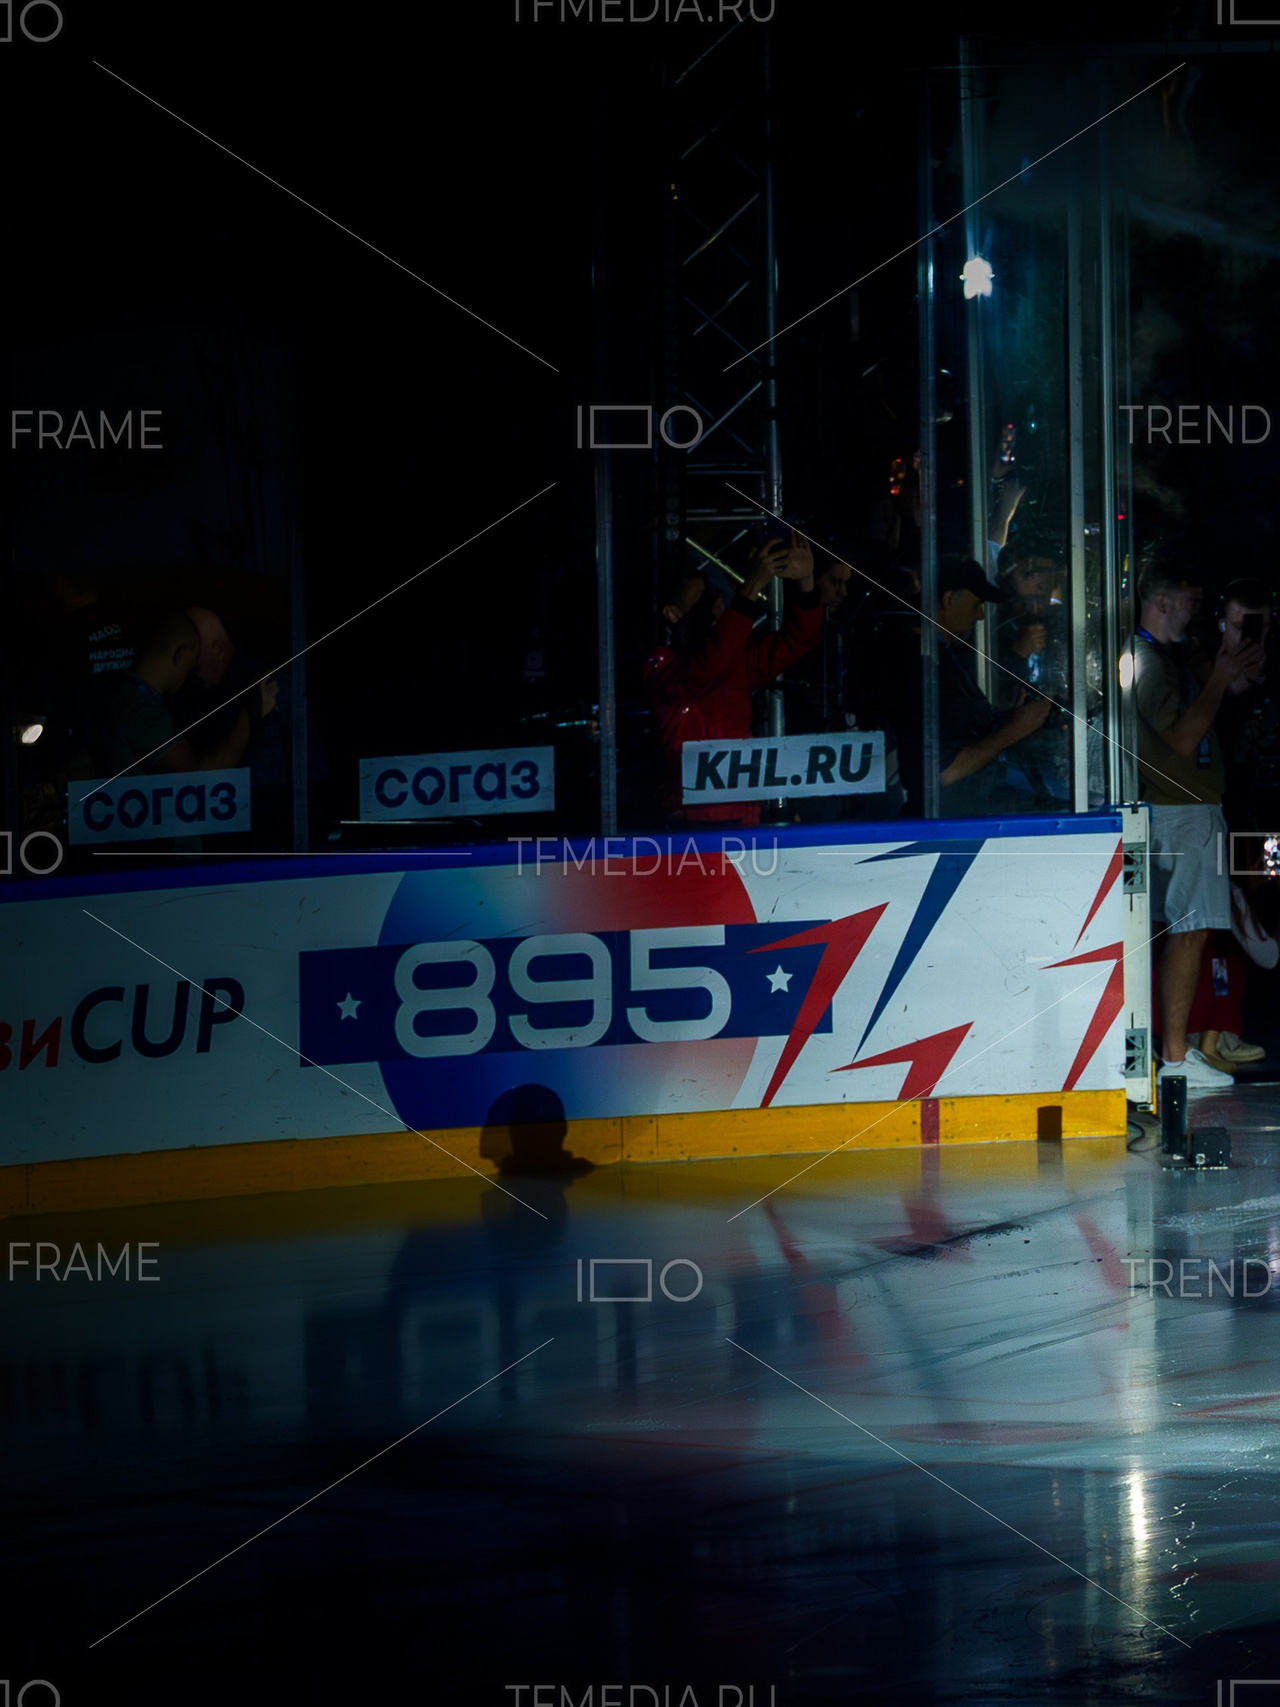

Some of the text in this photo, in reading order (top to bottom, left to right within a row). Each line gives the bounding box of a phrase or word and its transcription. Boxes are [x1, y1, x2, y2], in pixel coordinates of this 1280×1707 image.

[374, 759, 541, 809] согаз
[695, 742, 873, 791] KHL.RU
[82, 781, 237, 832] согаз
[393, 924, 732, 1058] 895
